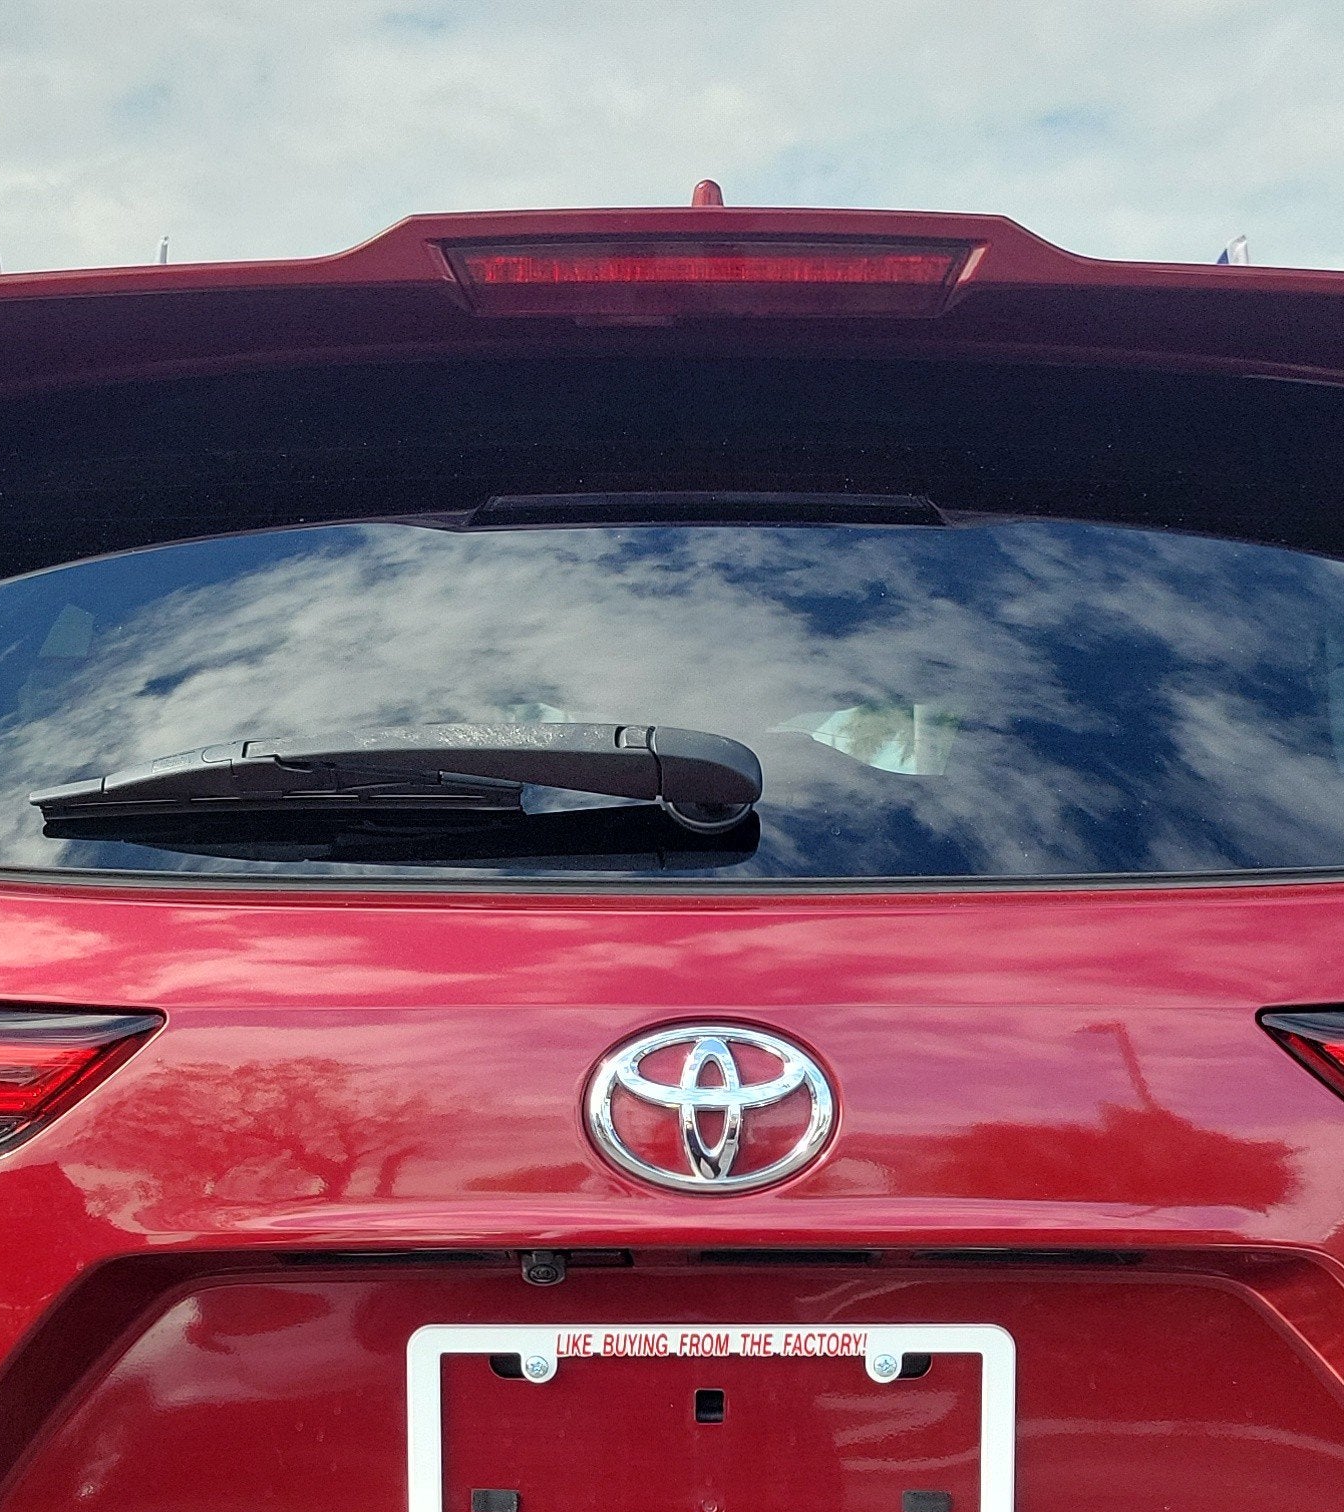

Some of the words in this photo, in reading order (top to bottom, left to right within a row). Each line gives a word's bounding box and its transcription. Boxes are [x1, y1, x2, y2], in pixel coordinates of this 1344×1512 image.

[556, 1333, 593, 1356] LIKE
[603, 1333, 668, 1356] BUYING
[679, 1333, 730, 1356] FROM
[740, 1333, 773, 1356] THE
[783, 1333, 869, 1356] FACTORY!
